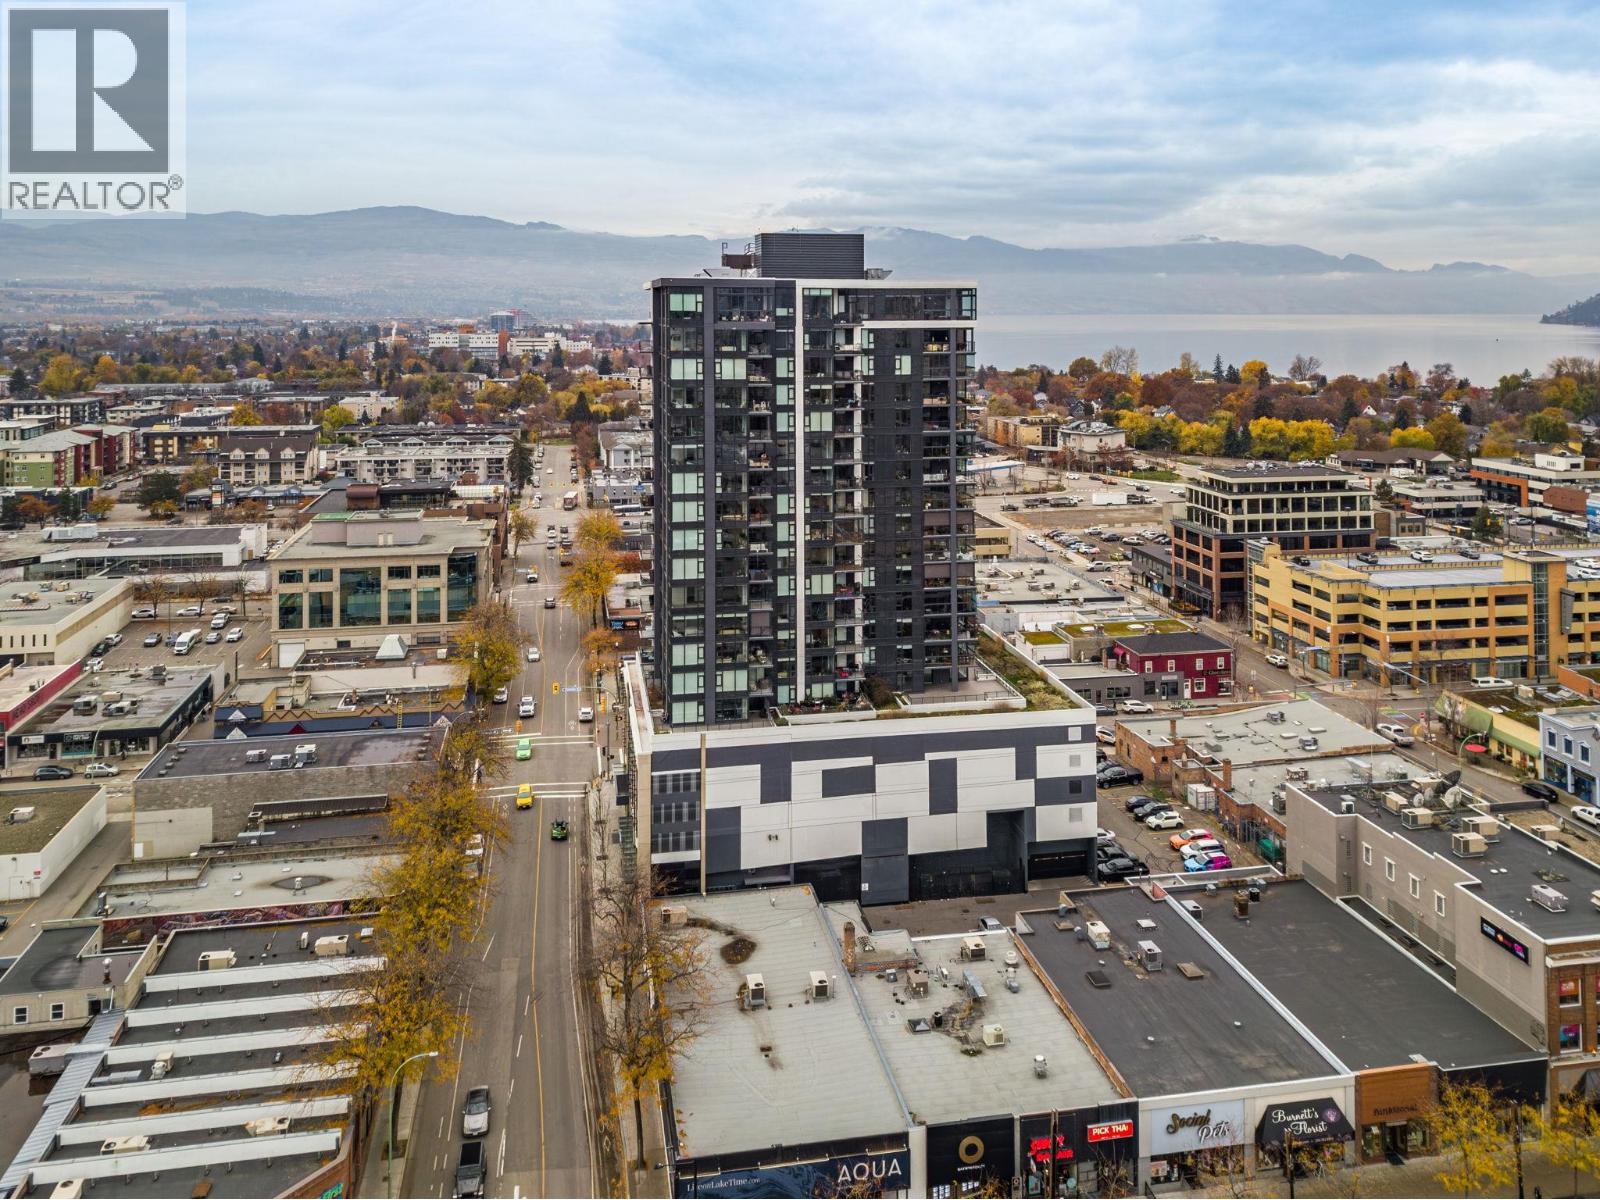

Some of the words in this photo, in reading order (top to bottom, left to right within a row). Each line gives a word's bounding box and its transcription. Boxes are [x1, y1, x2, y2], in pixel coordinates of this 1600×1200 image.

[1166, 1109, 1211, 1135] Social
[1272, 1108, 1319, 1124] Burnett's
[1092, 1126, 1110, 1136] PICK
[1198, 1121, 1230, 1144] Pets
[1290, 1121, 1328, 1135] Florist
[837, 1158, 902, 1183] AQUA
